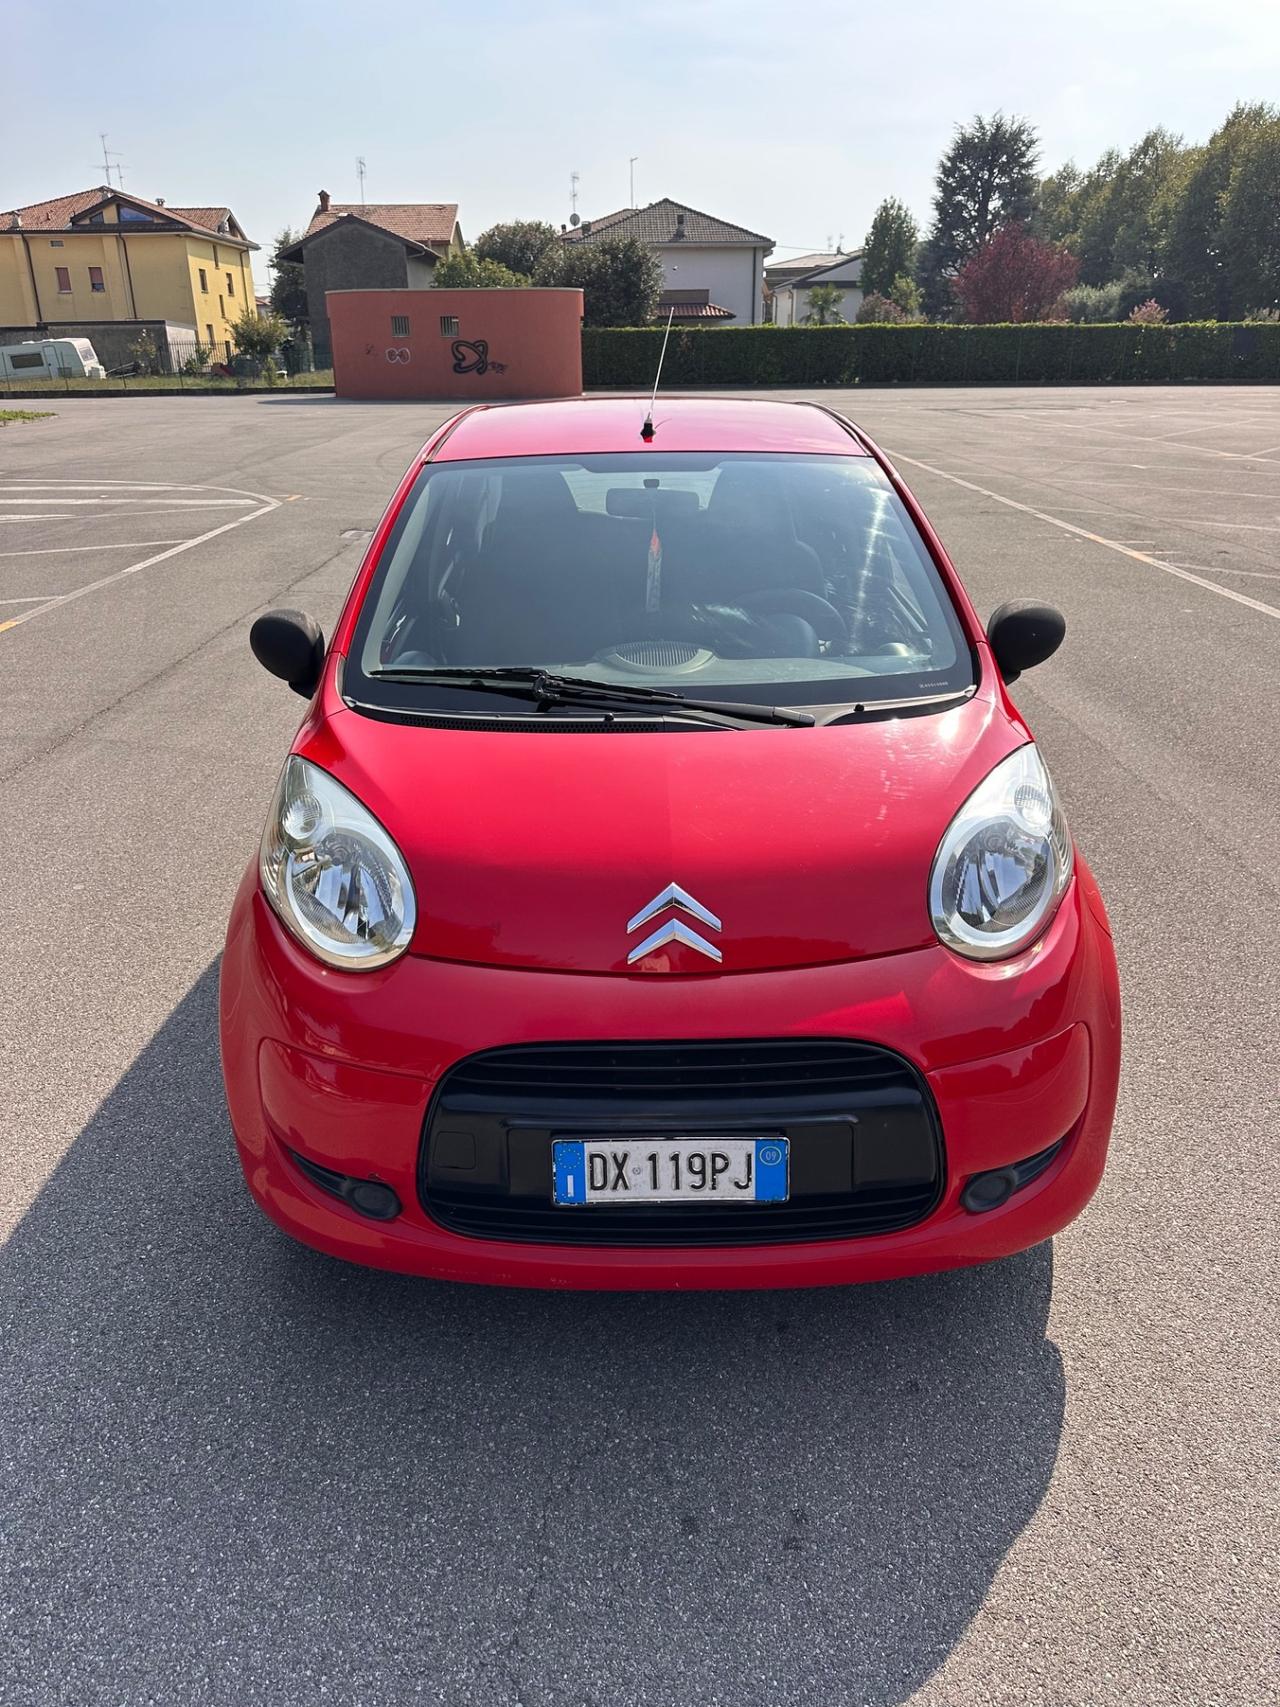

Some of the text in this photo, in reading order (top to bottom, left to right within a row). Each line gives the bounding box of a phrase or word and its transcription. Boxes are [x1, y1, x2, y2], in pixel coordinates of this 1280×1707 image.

[765, 1151, 777, 1161] 09
[588, 1151, 752, 1191] DX 119PJ
[566, 1174, 574, 1197] I
